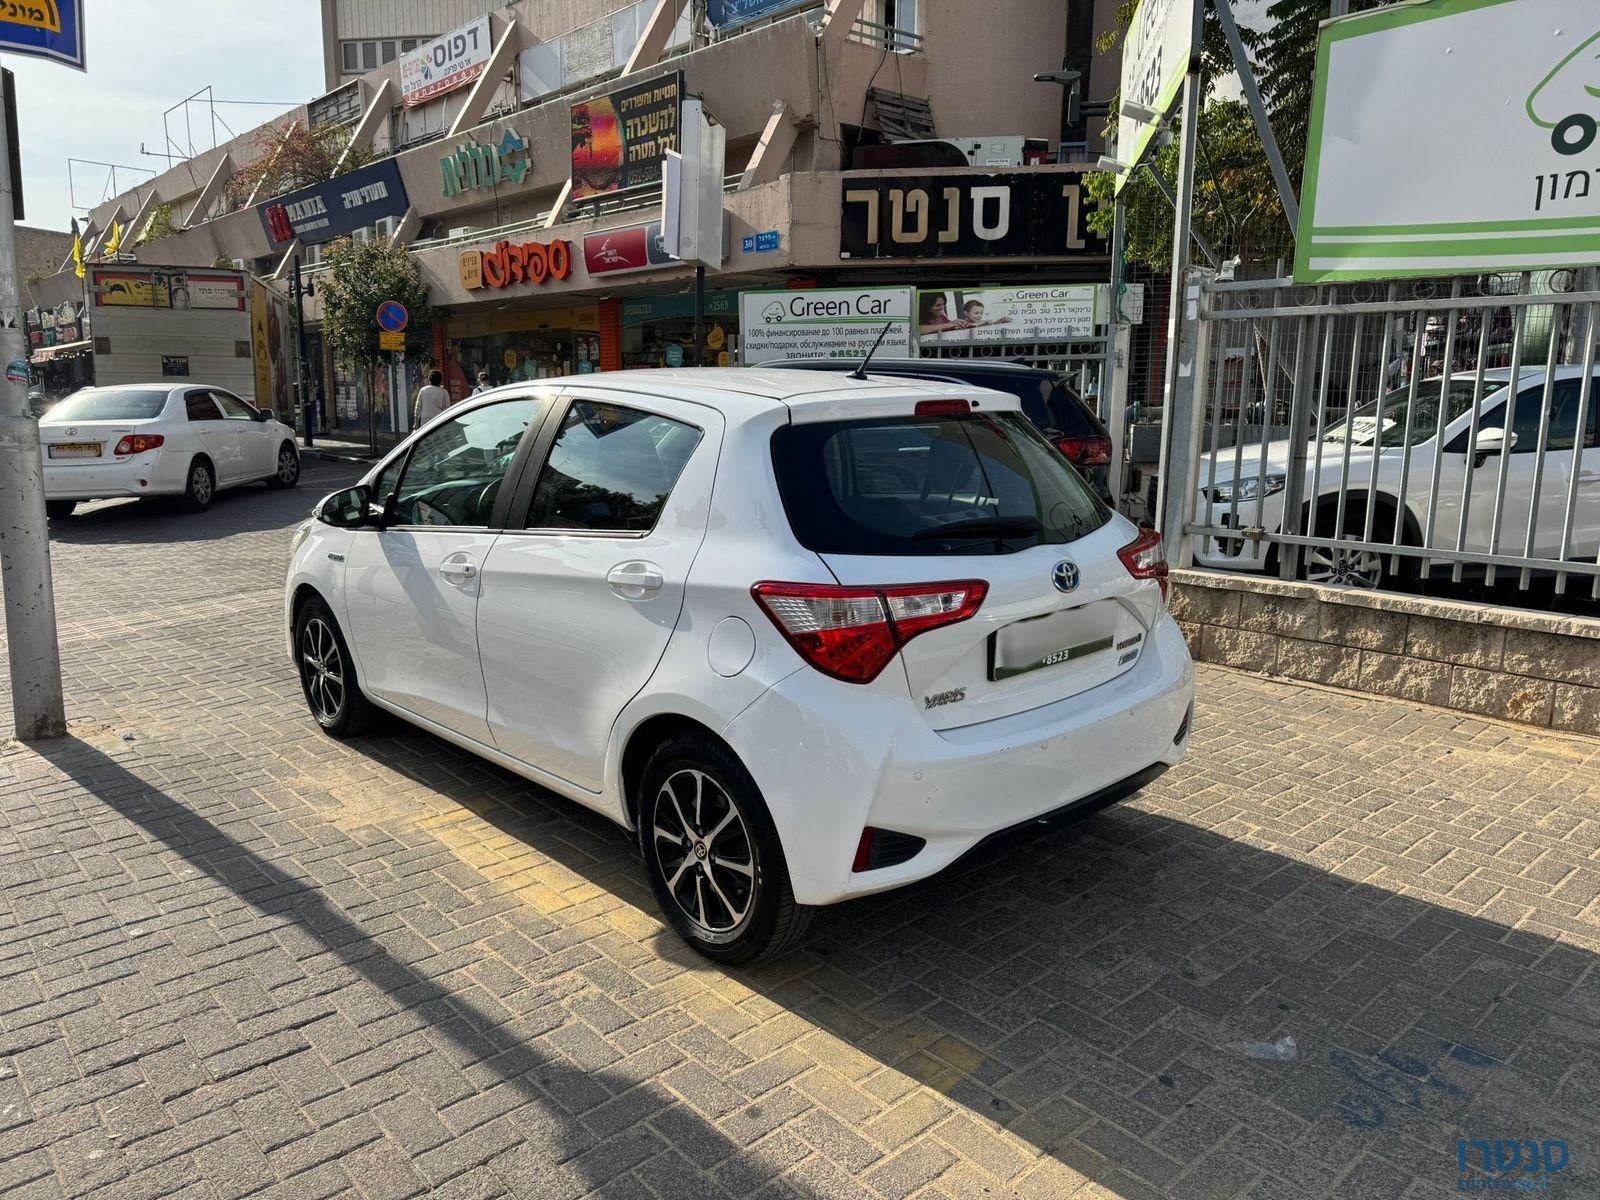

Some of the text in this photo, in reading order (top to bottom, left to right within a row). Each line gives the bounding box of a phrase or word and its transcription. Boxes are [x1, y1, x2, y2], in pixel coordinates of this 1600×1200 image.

[433, 27, 479, 68] דפוס
[626, 104, 677, 140] להשכרה
[629, 141, 656, 163] מטרה
[1535, 168, 1600, 211] מון
[846, 185, 1011, 244] סנטר
[744, 239, 753, 249] 30
[790, 294, 891, 317] Green Car
[1016, 289, 1069, 299] Green Car
[766, 327, 820, 339] финансирование
[821, 329, 831, 337] до
[832, 327, 844, 336] 100
[845, 328, 869, 338] равных
